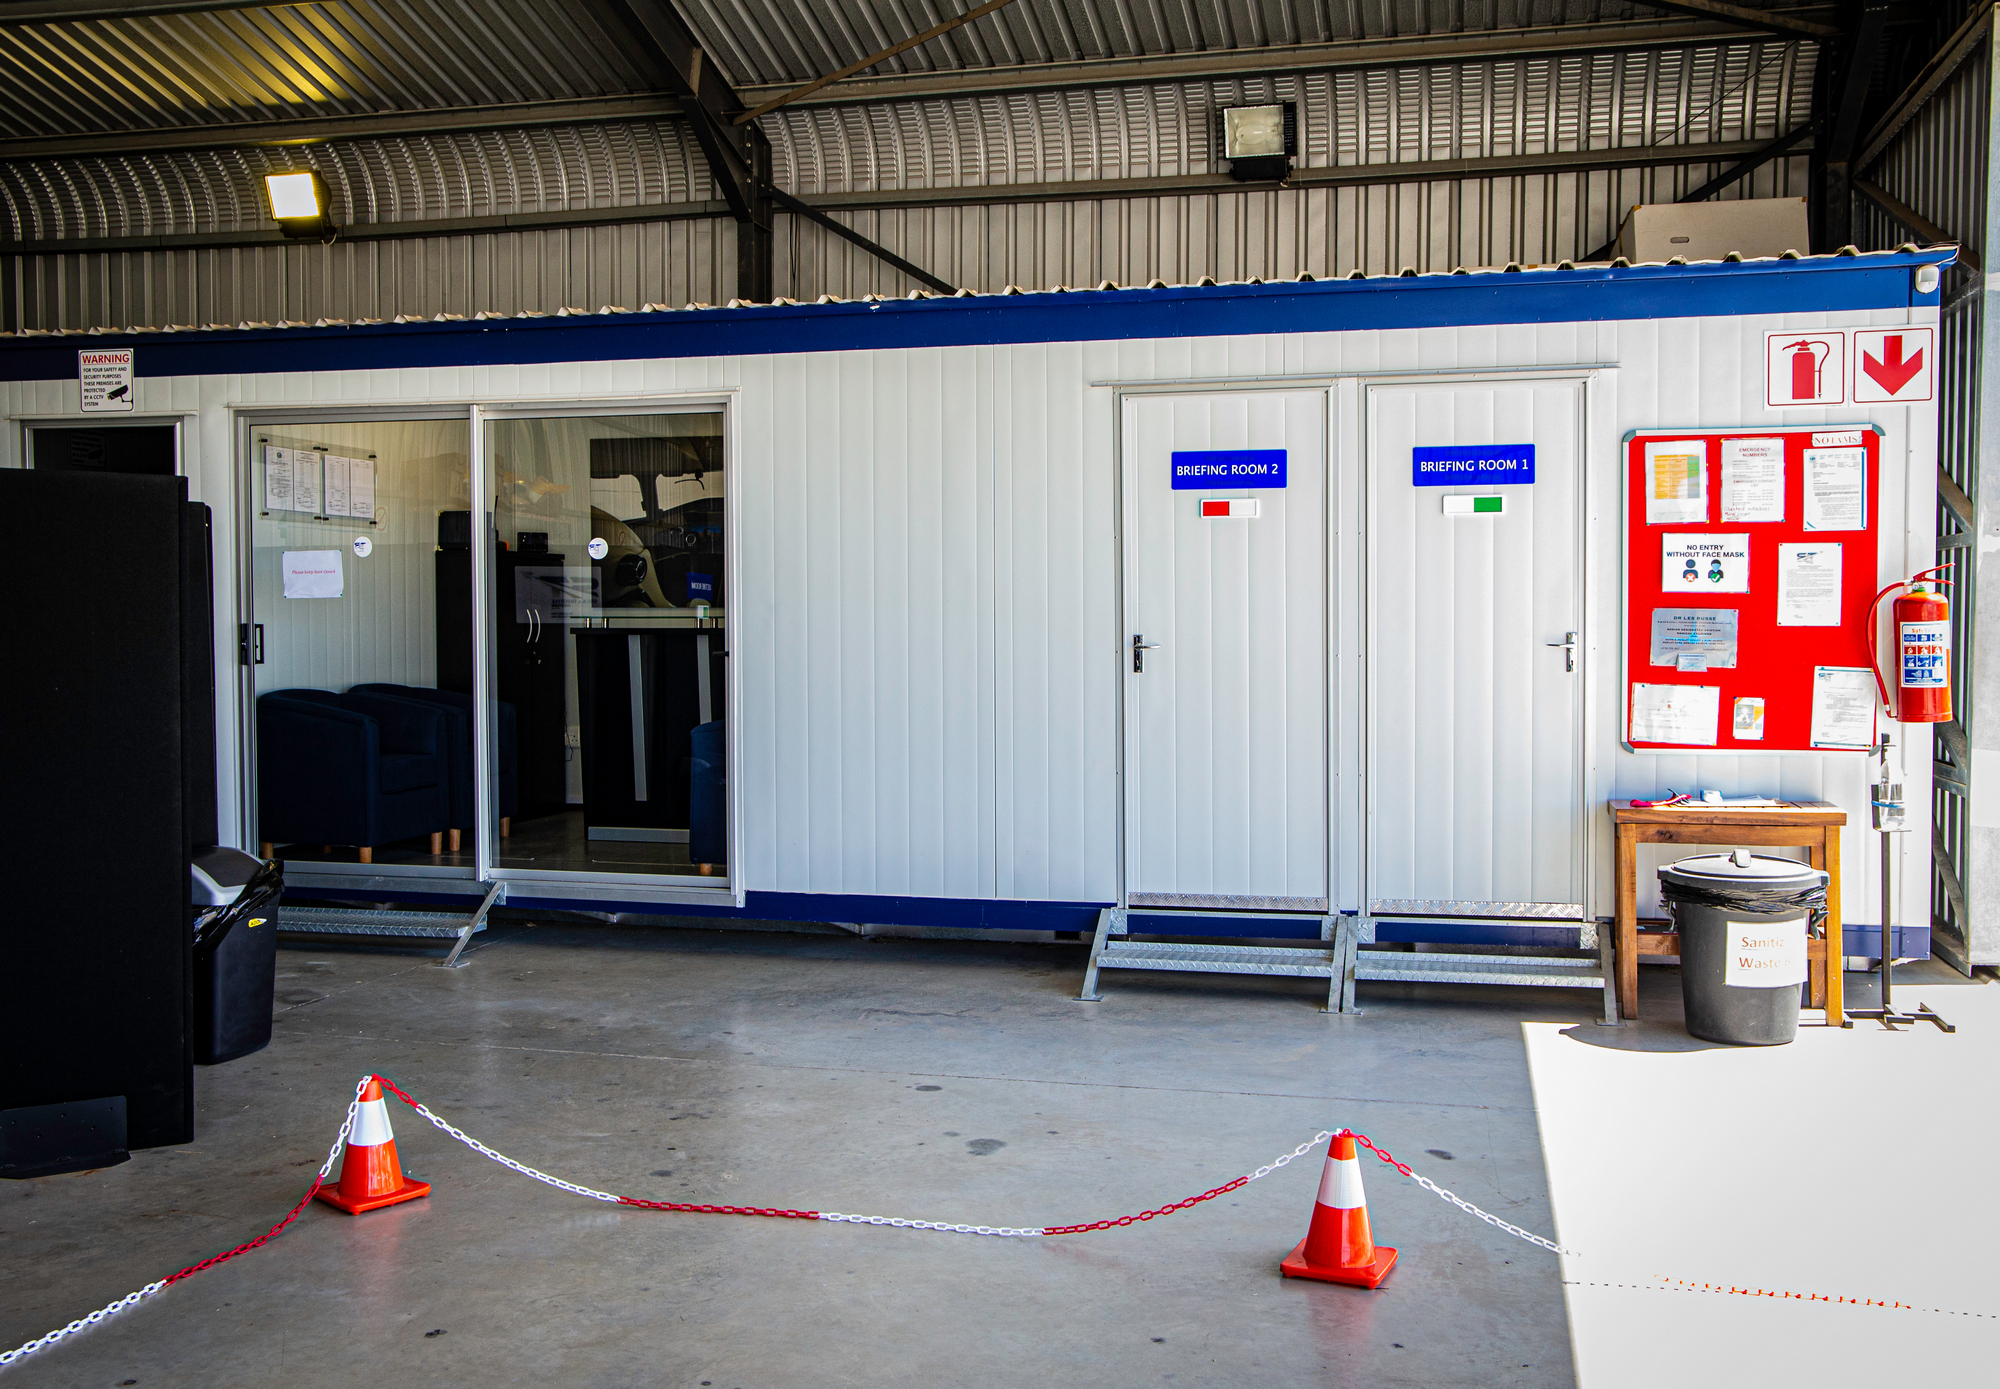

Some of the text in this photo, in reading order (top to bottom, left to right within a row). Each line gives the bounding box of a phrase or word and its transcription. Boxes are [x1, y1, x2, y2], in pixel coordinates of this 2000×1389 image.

[82, 354, 130, 364] WARNING
[1176, 463, 1278, 476] BRIEFING ROOM 2
[1420, 459, 1529, 472] BRIEFING ROOM 1
[1738, 956, 1781, 969] Waste
